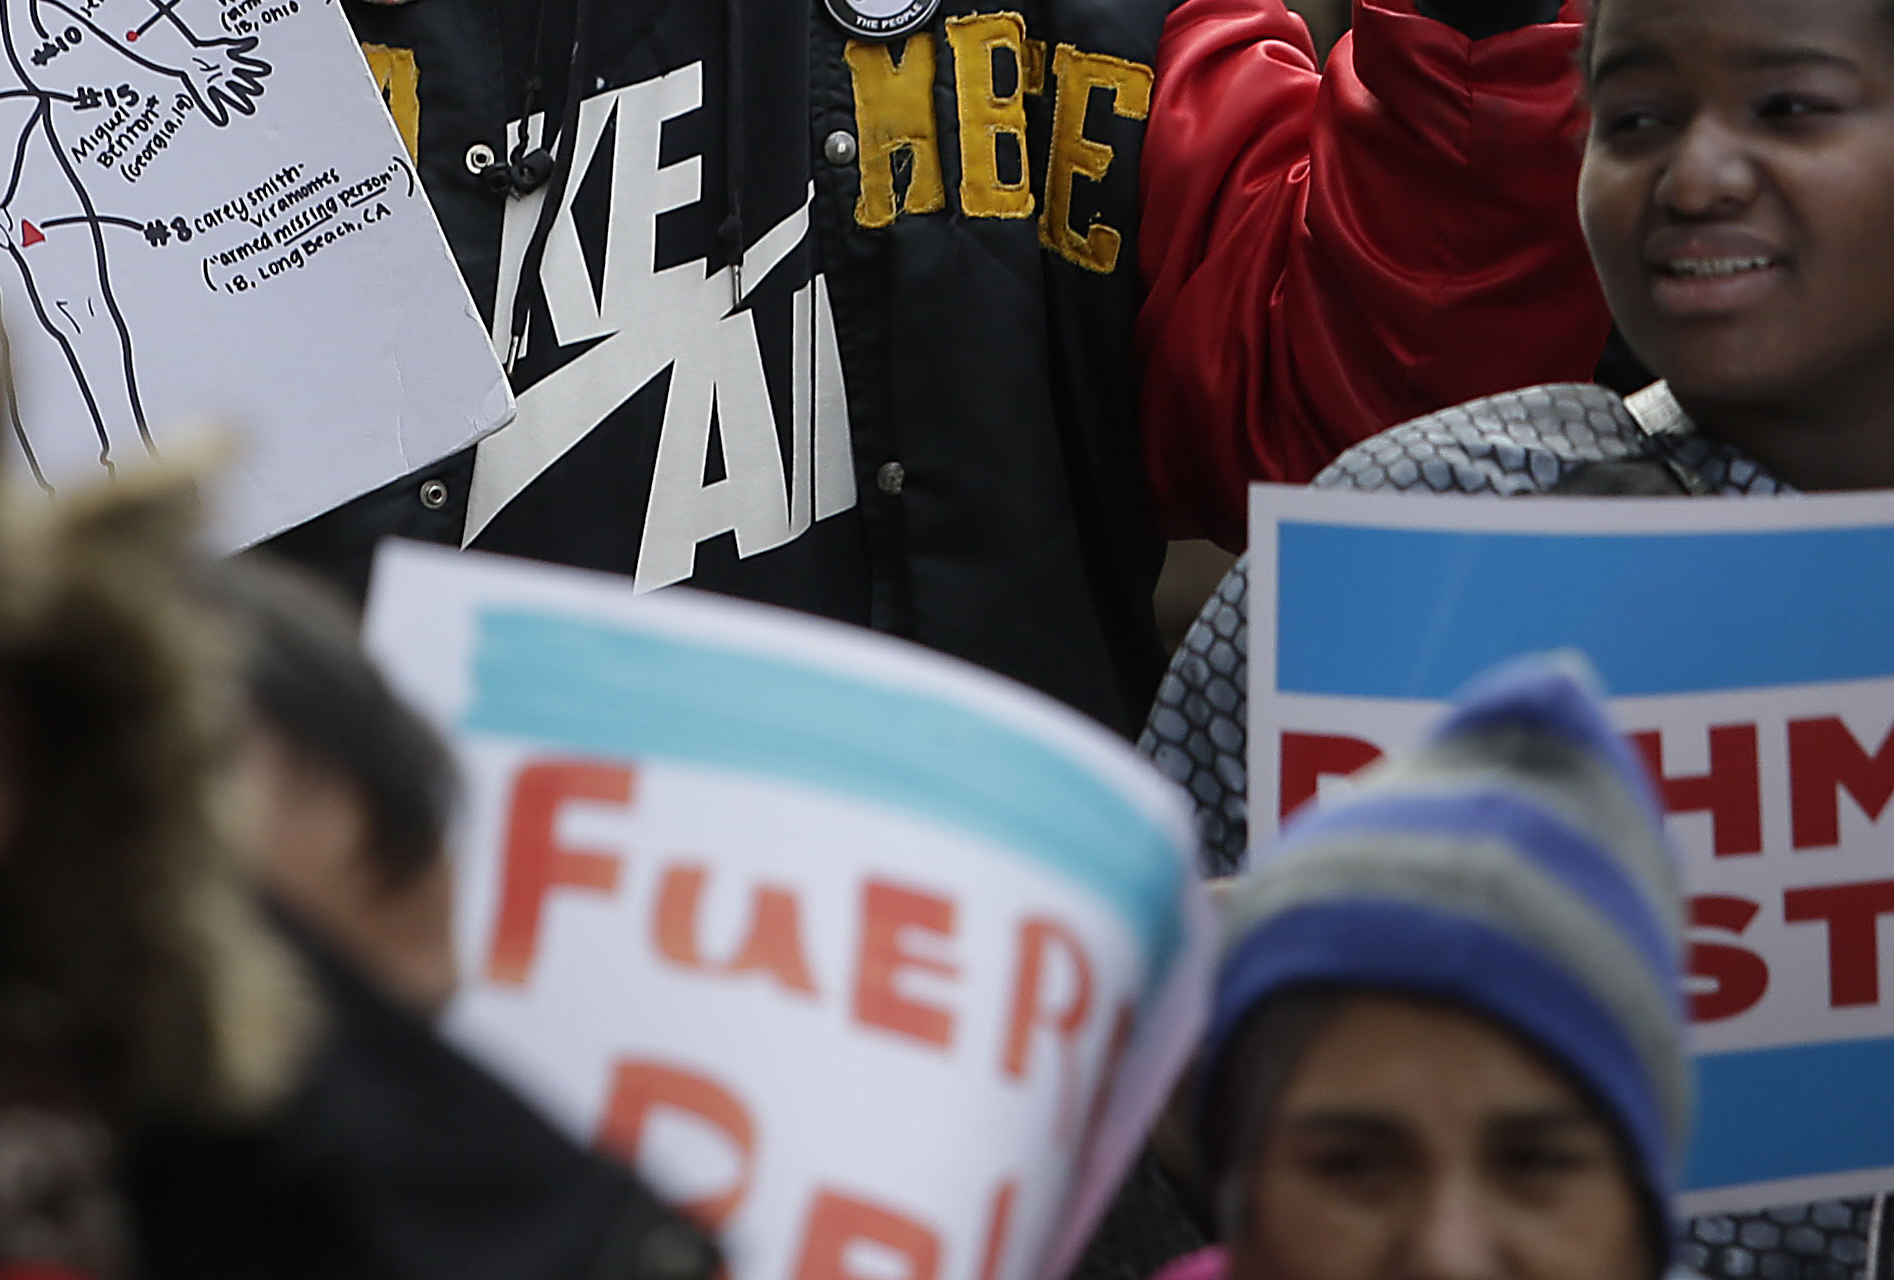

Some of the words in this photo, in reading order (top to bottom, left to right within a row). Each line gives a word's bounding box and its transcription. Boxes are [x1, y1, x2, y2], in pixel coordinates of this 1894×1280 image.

[855, 13, 880, 30] THE
[879, 0, 924, 30] PEOPLE
[70, 104, 131, 164] Miguel
[362, 201, 393, 225] CA
